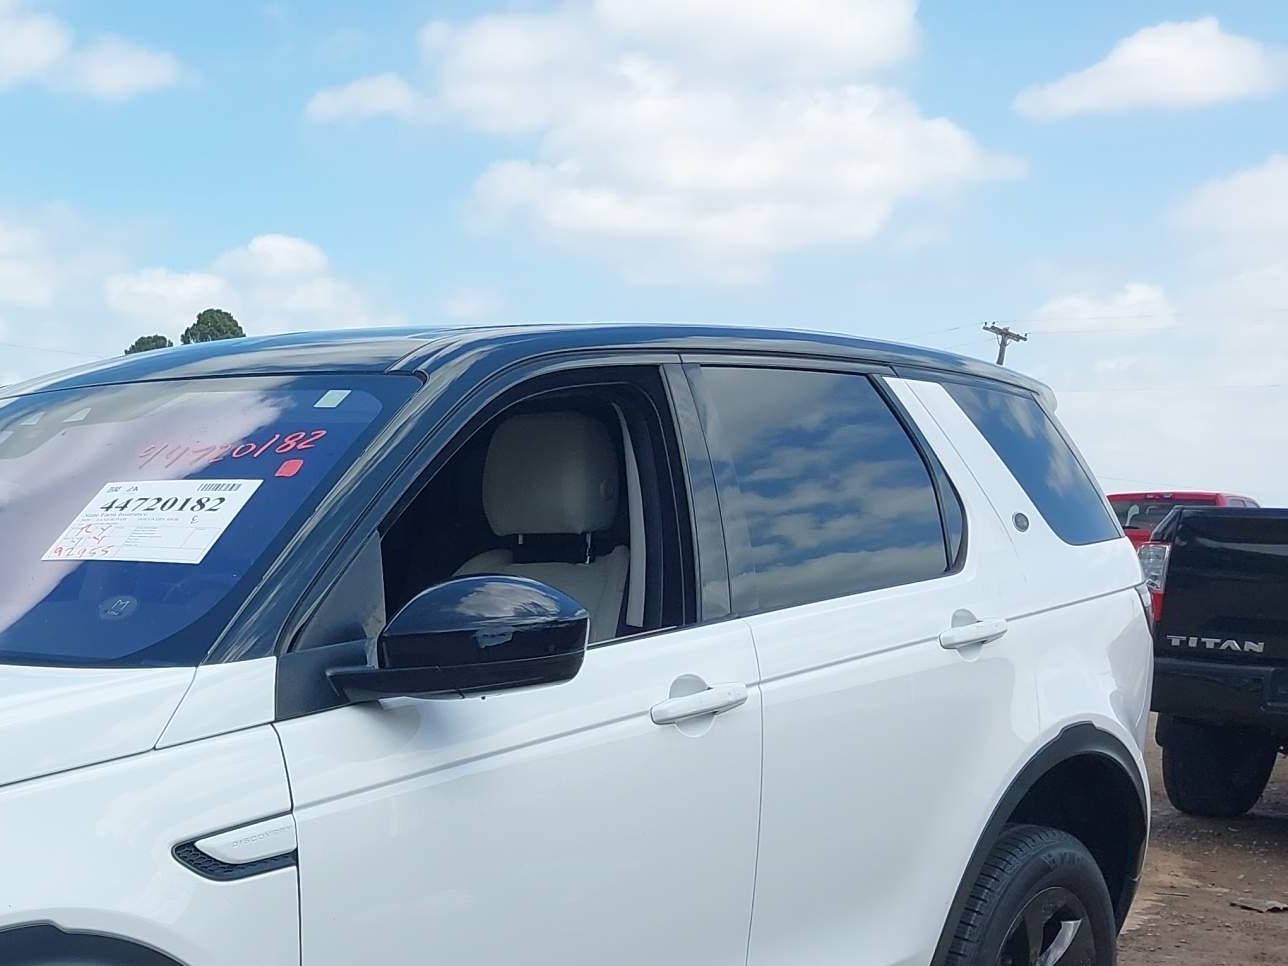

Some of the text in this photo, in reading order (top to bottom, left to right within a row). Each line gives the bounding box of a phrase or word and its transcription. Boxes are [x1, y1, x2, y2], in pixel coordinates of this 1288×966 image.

[139, 430, 328, 470] 44720182
[99, 496, 226, 512] 44720182
[1166, 635, 1265, 653] TITAN
